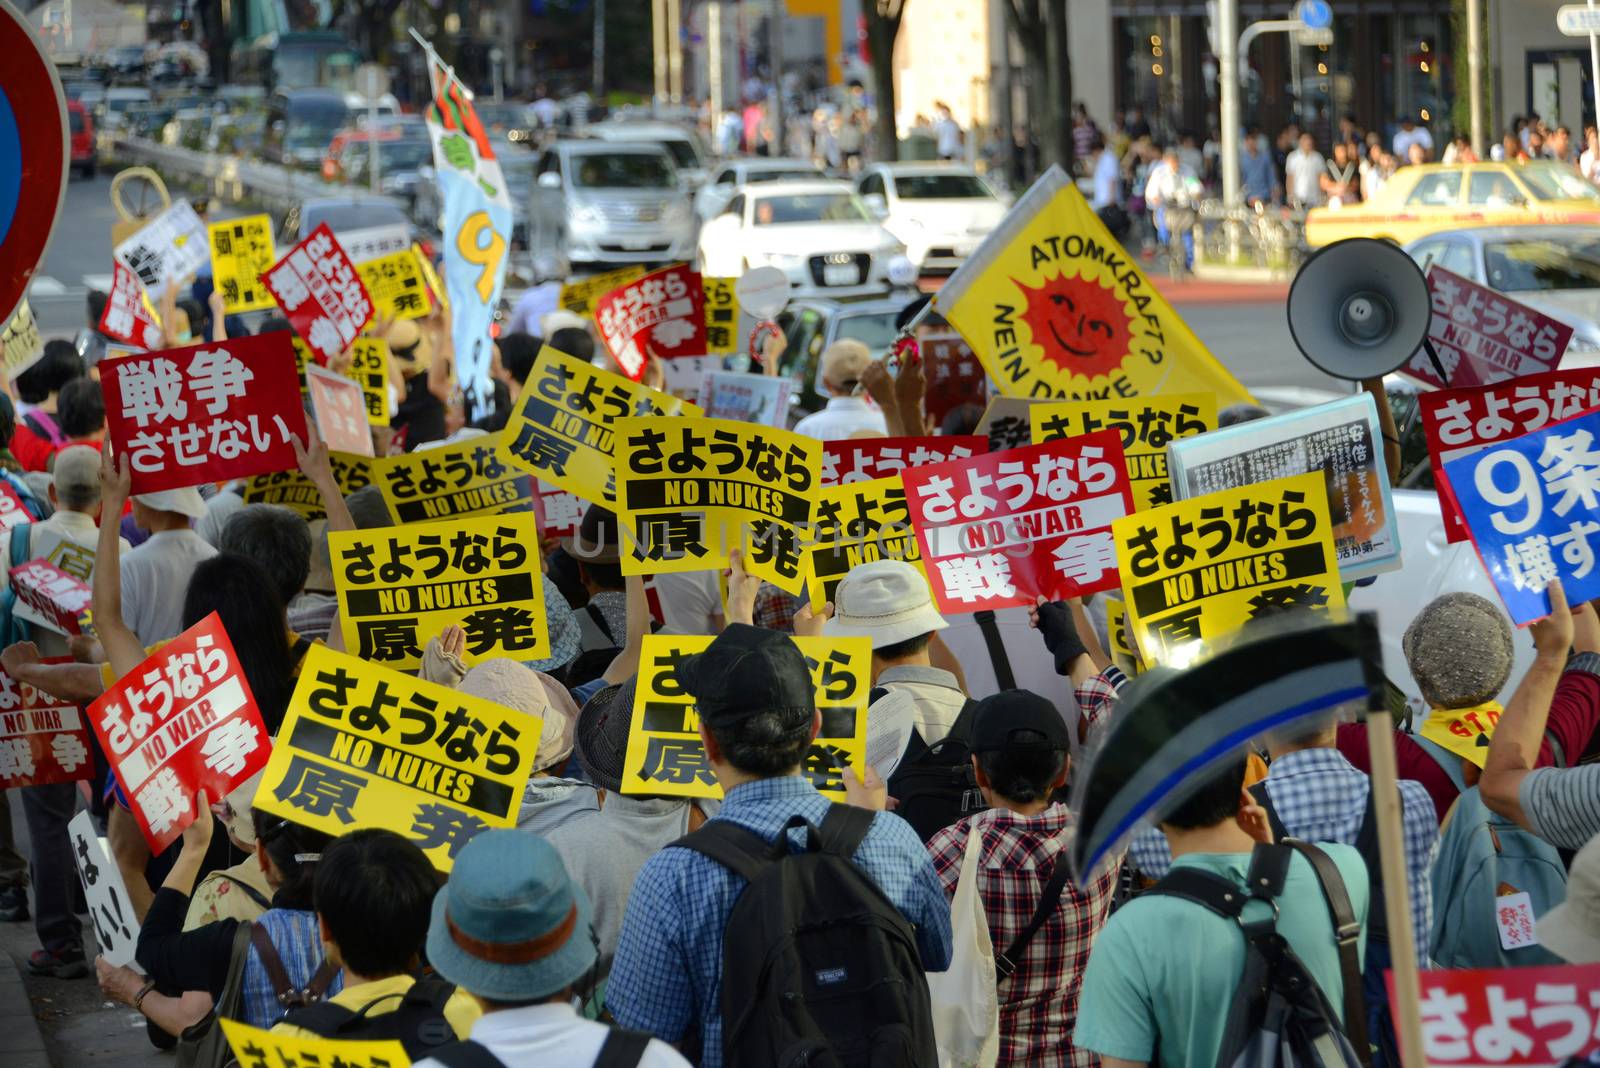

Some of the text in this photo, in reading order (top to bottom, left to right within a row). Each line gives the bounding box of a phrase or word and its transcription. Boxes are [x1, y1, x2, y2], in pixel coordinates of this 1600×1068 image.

[456, 209, 506, 305] 9
[1030, 235, 1165, 366] ATOMKRAFT?
[1432, 279, 1559, 361] さようなら
[993, 304, 1031, 383] NEIN
[1442, 322, 1523, 372] NO WAR
[117, 348, 255, 427] 戦争
[538, 364, 686, 424] さよう
[1434, 378, 1600, 445] さような
[128, 414, 292, 473] させない
[551, 410, 583, 439] NO
[386, 446, 522, 498] さような
[628, 428, 812, 492] さようなら
[917, 446, 1117, 523] さようなら
[422, 495, 451, 518] NO
[452, 480, 520, 513] NUKES
[664, 480, 785, 518] NO NUKES
[967, 505, 1084, 549] NO WAR
[342, 526, 527, 585] さようなら
[1126, 490, 1317, 578] さようなら
[1336, 541, 1385, 562] 活が第一
[378, 578, 498, 614] NO NUKES
[1162, 551, 1288, 608] NO NUKES
[3, 710, 62, 734] NO WAR
[101, 634, 228, 756] さようなら
[308, 667, 521, 776] さようなら
[140, 699, 219, 772] NO WAR
[330, 731, 475, 804] NO NUKES
[1420, 983, 1600, 1062] さよう
